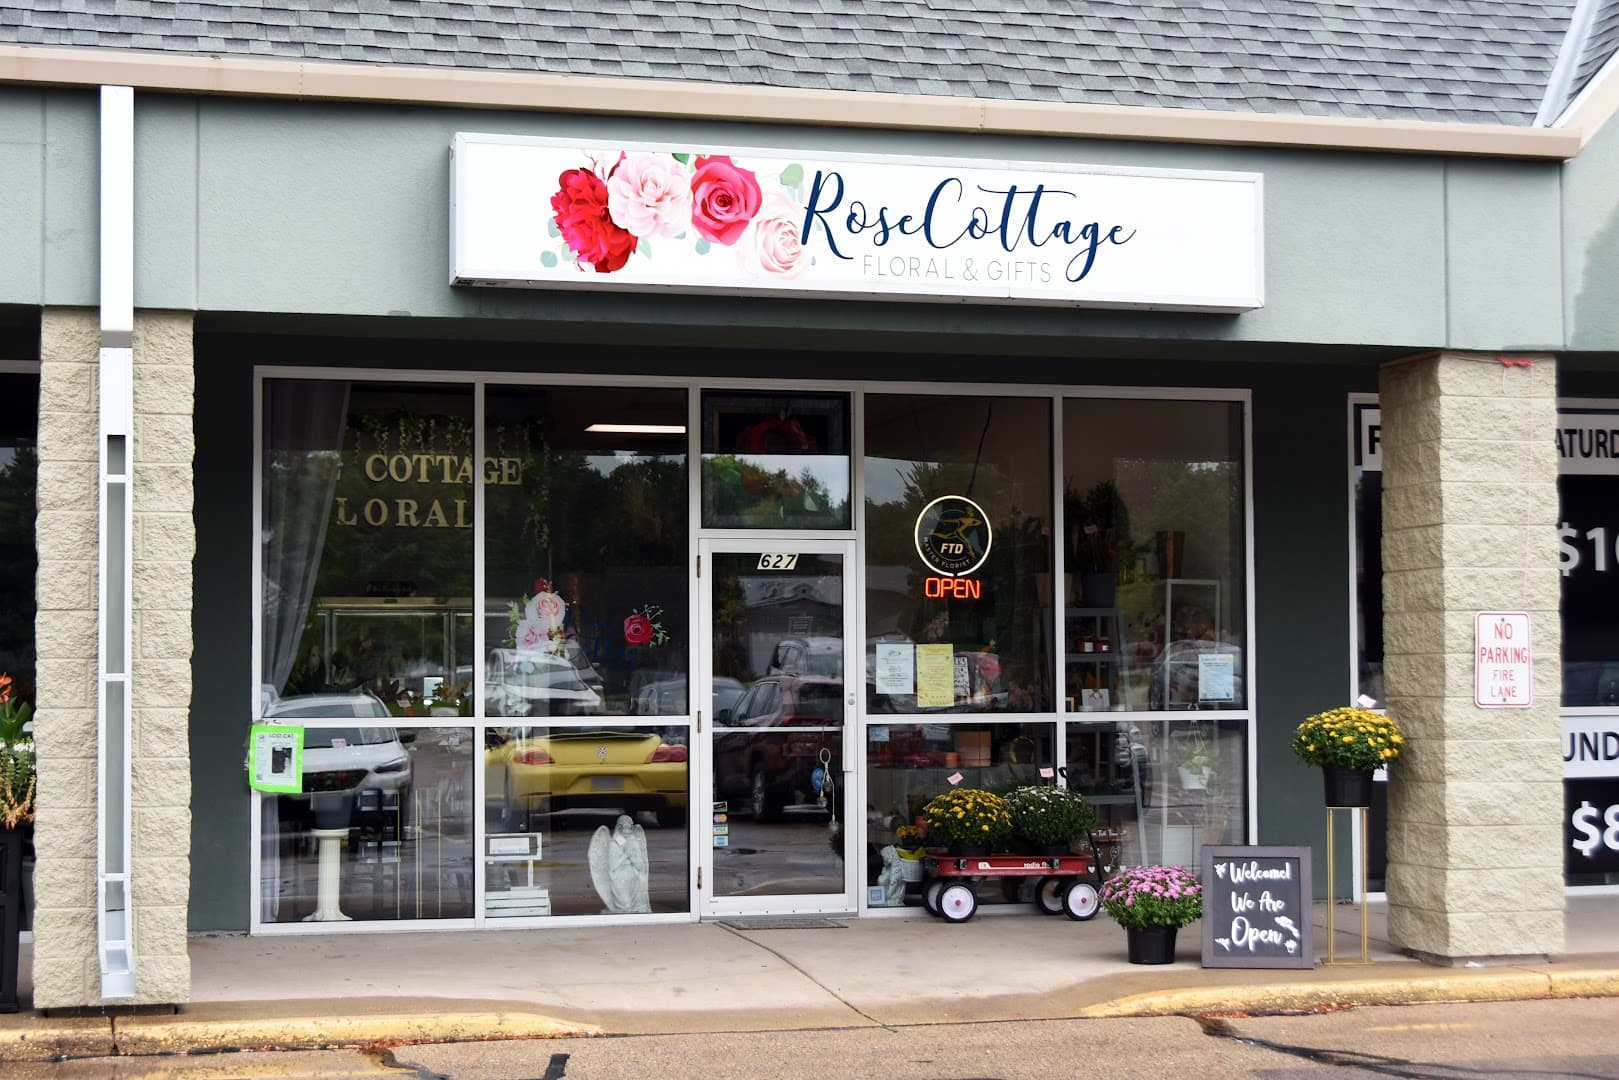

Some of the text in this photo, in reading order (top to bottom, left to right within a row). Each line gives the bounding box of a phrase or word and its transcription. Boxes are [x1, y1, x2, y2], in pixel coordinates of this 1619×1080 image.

[862, 254, 1052, 283] FLORAL & GIFTS
[365, 453, 522, 485] COTTAGE
[940, 543, 964, 554] FTD
[1558, 521, 1619, 577] $1
[760, 554, 797, 569] 627
[924, 577, 981, 599] OPEN
[1494, 622, 1514, 640] NO
[1480, 646, 1528, 664] PARKING
[1492, 669, 1515, 681] FIRE
[1490, 686, 1518, 698] LANE
[1231, 890, 1285, 912] We Are
[1231, 916, 1283, 951] Open
